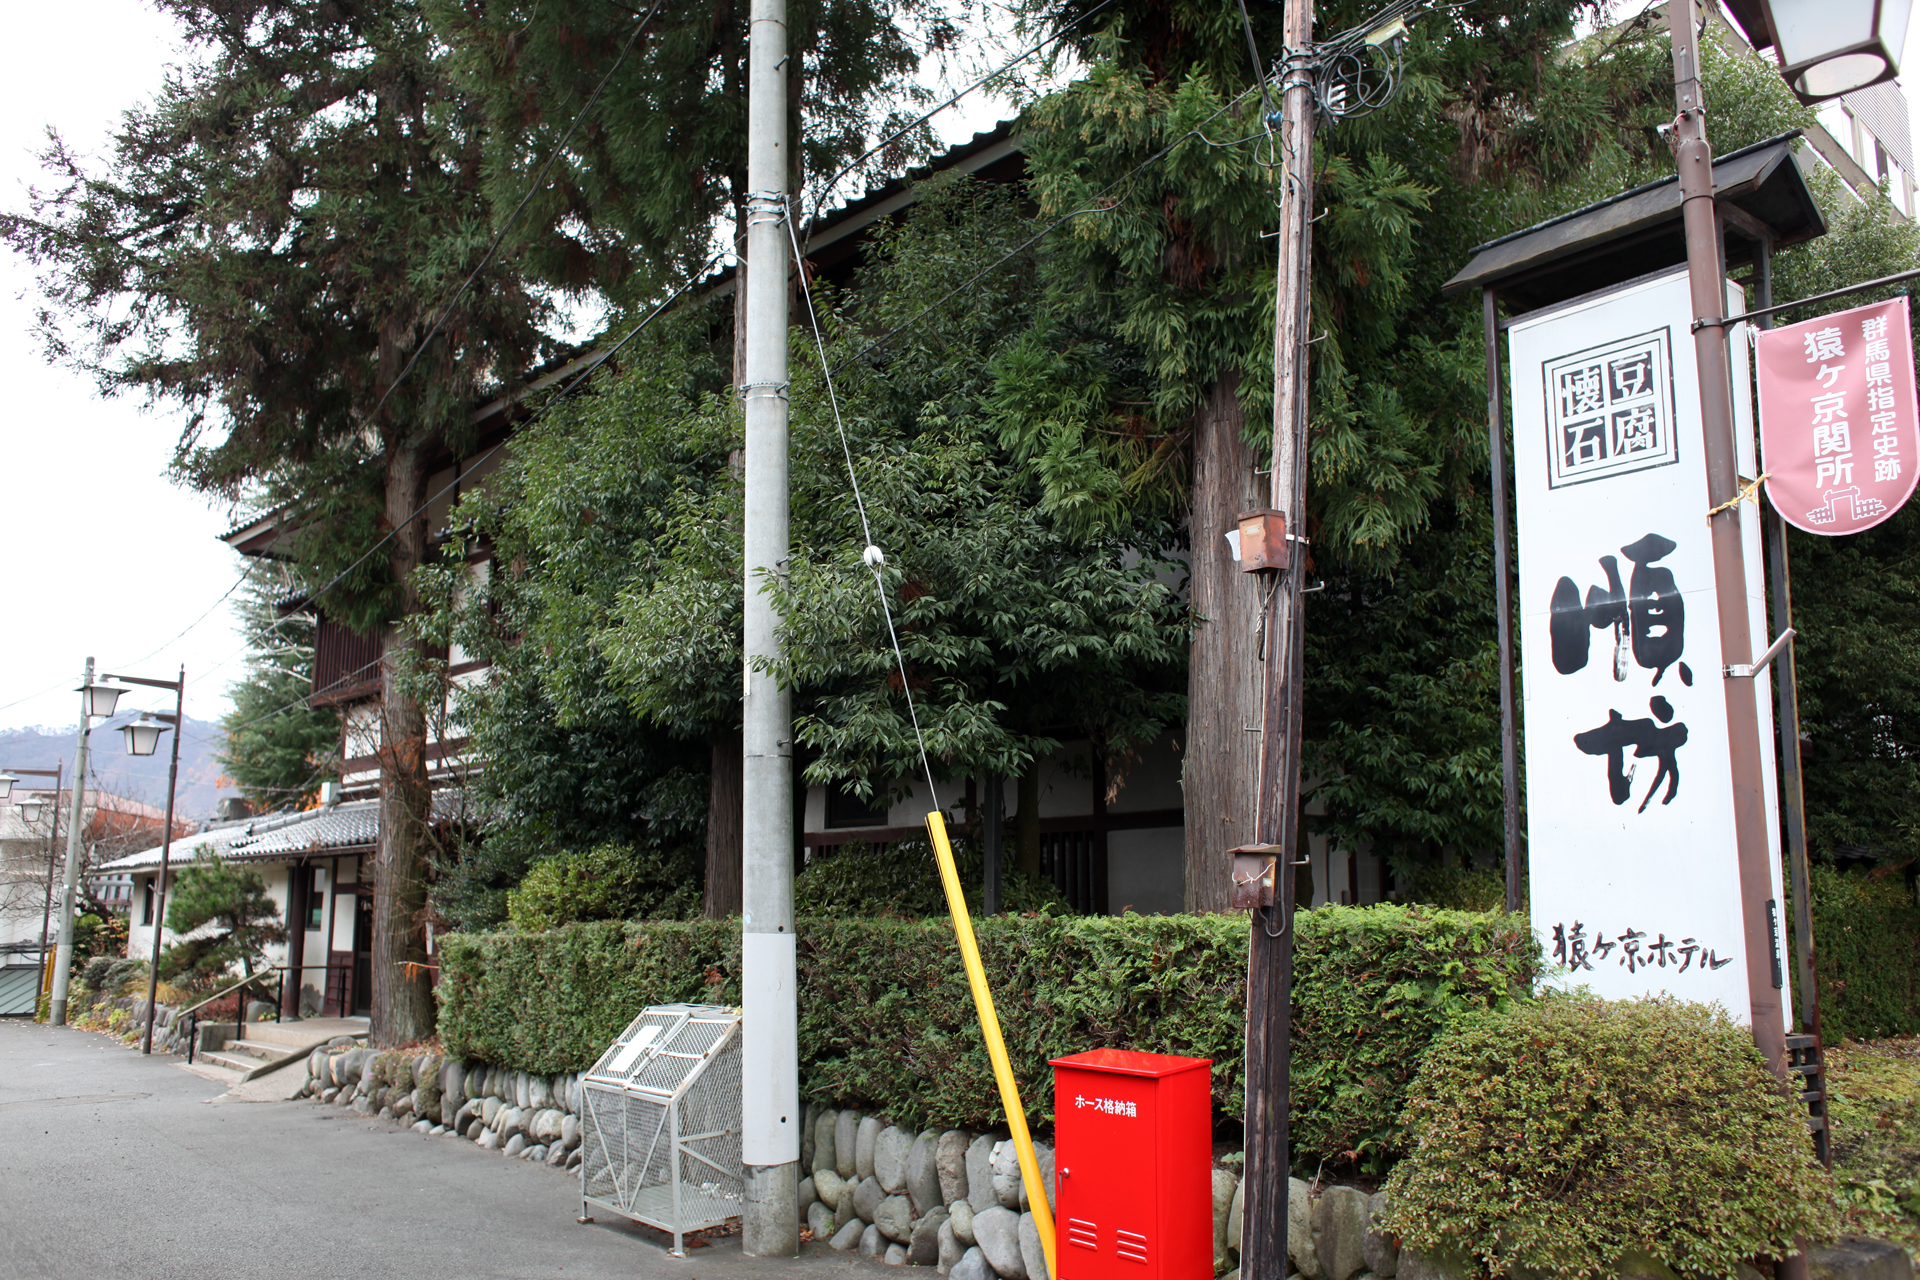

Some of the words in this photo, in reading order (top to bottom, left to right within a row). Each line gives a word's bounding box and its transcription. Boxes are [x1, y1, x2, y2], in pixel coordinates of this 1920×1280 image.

[1561, 367, 1605, 465] 懐石
[1611, 352, 1656, 456] 豆腐
[1862, 314, 1902, 483] 群馬県指定史跡
[1075, 1094, 1137, 1118] ホース格納箱
